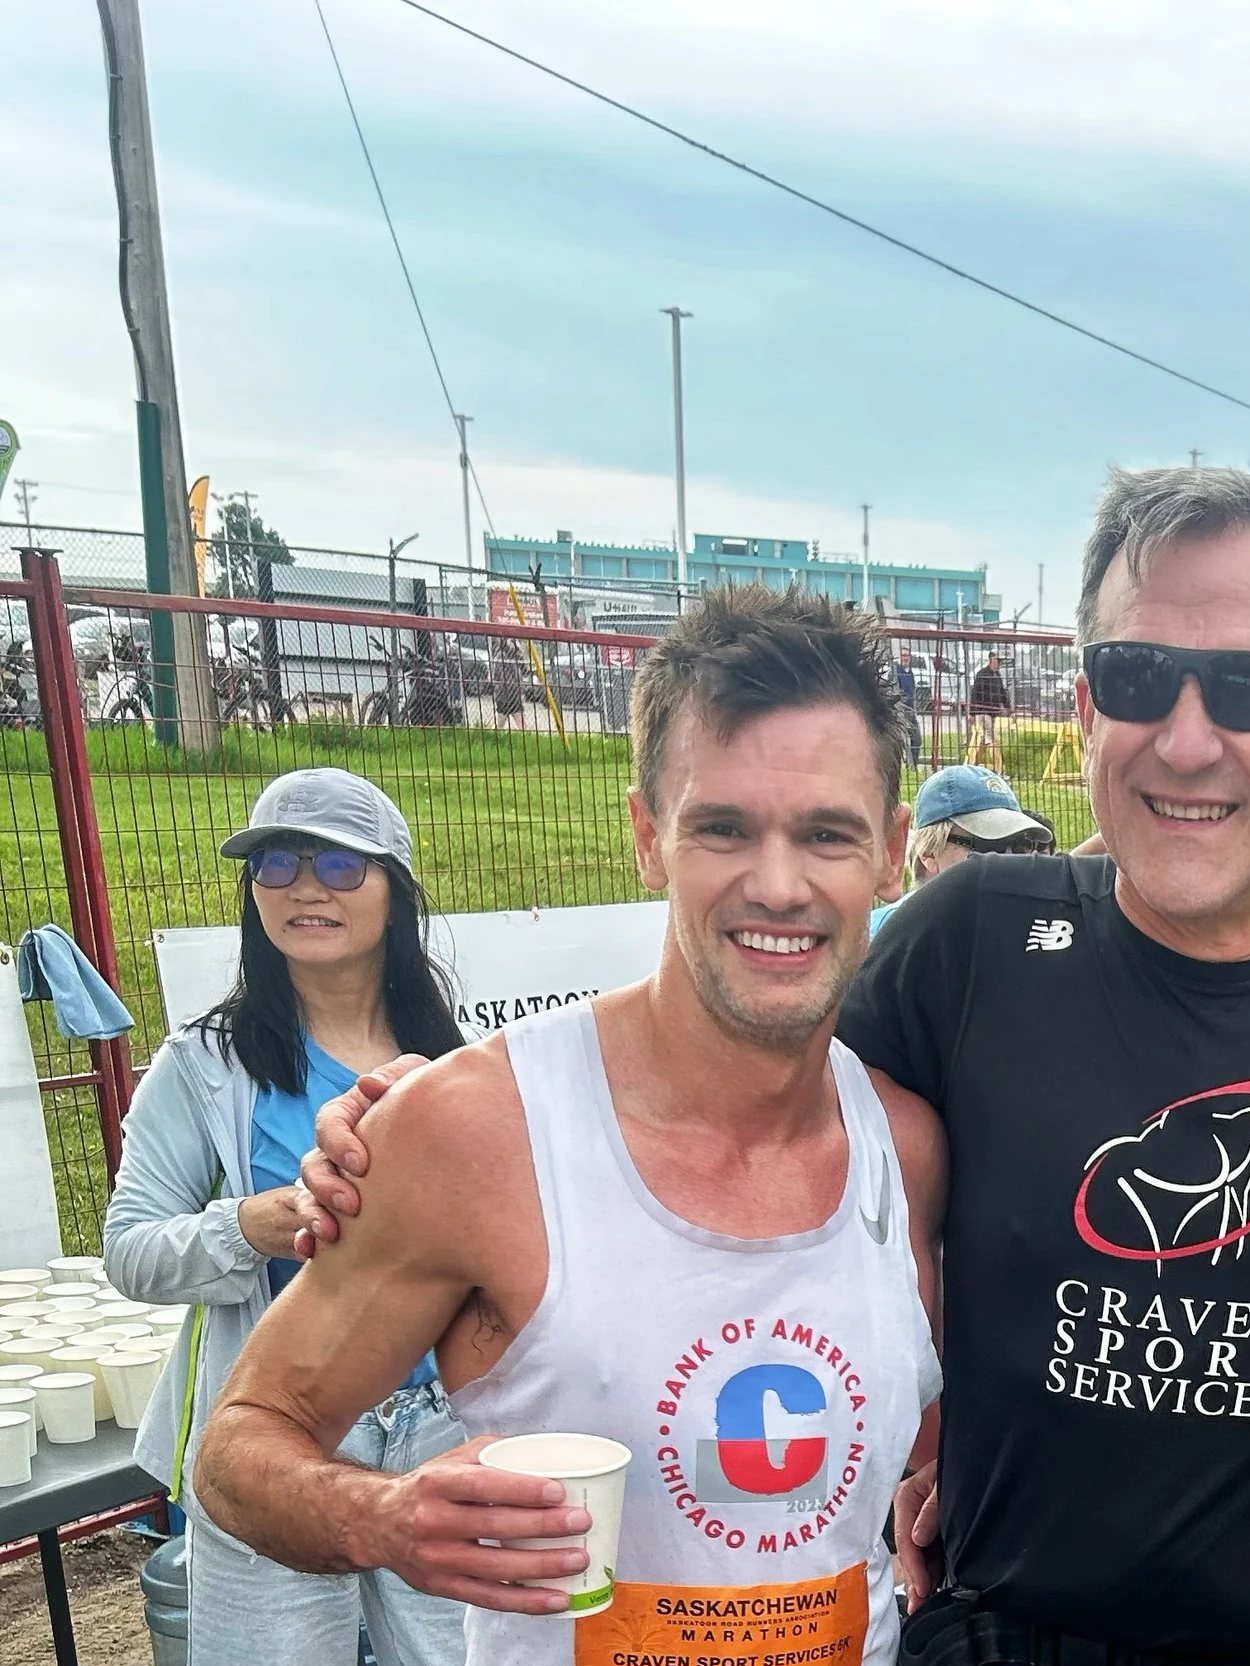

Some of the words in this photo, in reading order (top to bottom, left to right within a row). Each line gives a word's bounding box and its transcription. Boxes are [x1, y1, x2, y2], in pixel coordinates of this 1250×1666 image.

[656, 1337, 714, 1417] BANK
[721, 1318, 756, 1345] OF
[771, 1318, 867, 1413] AMERICA
[656, 1445, 747, 1550] CHICAGO
[756, 1442, 865, 1554] MARATHON
[655, 1588, 838, 1618] SASKATCHEWAN
[666, 1619, 718, 1628] SASKATOON
[746, 1617, 784, 1627] RUNNERS
[785, 1610, 831, 1624] ASSOCIATION
[681, 1622, 818, 1643] MARATHON
